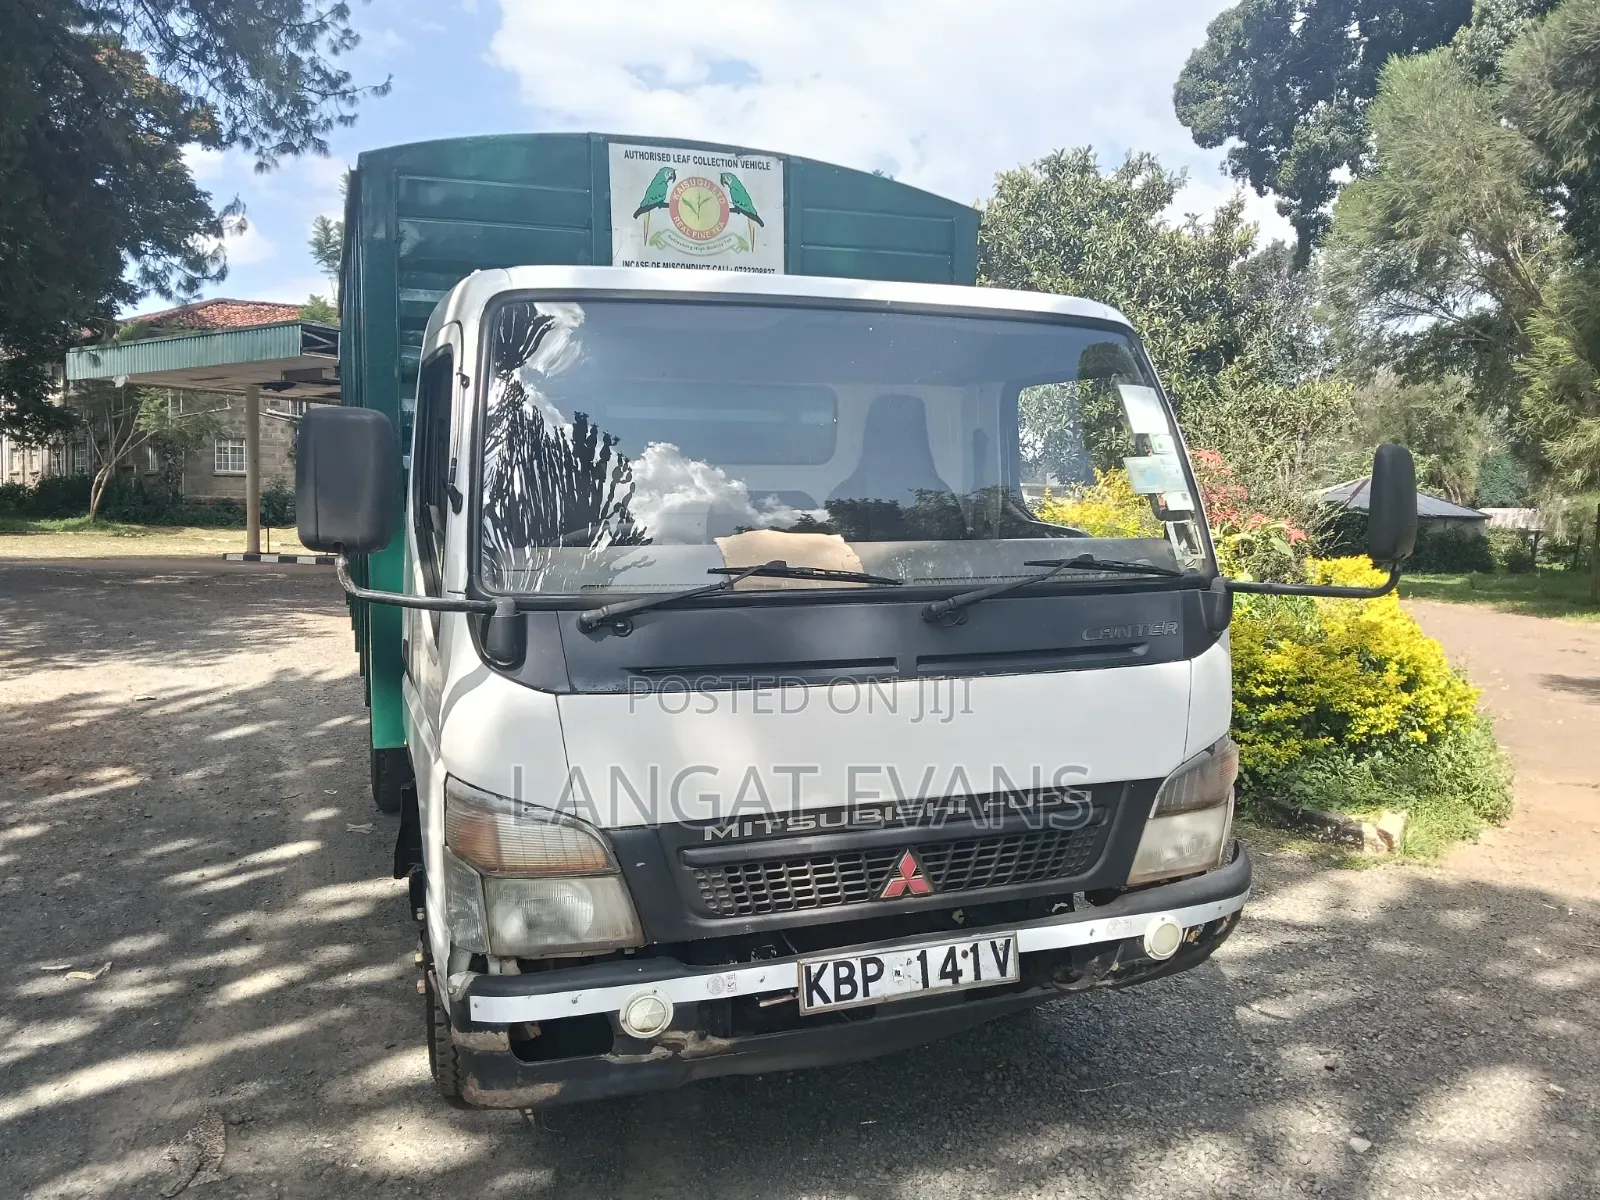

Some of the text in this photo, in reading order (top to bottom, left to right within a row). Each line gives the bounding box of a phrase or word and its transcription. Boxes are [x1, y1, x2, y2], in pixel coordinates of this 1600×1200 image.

[624, 150, 771, 171] AUTHORISED LEAF COLLECTION VEHICLE
[673, 179, 726, 204] KAISUGU LTD
[673, 216, 725, 239] REAL FINE TEA
[1081, 621, 1179, 641] CANTER
[703, 789, 1093, 842] MITSUBISHI FUSO
[804, 938, 1011, 1007] KBP 141V
